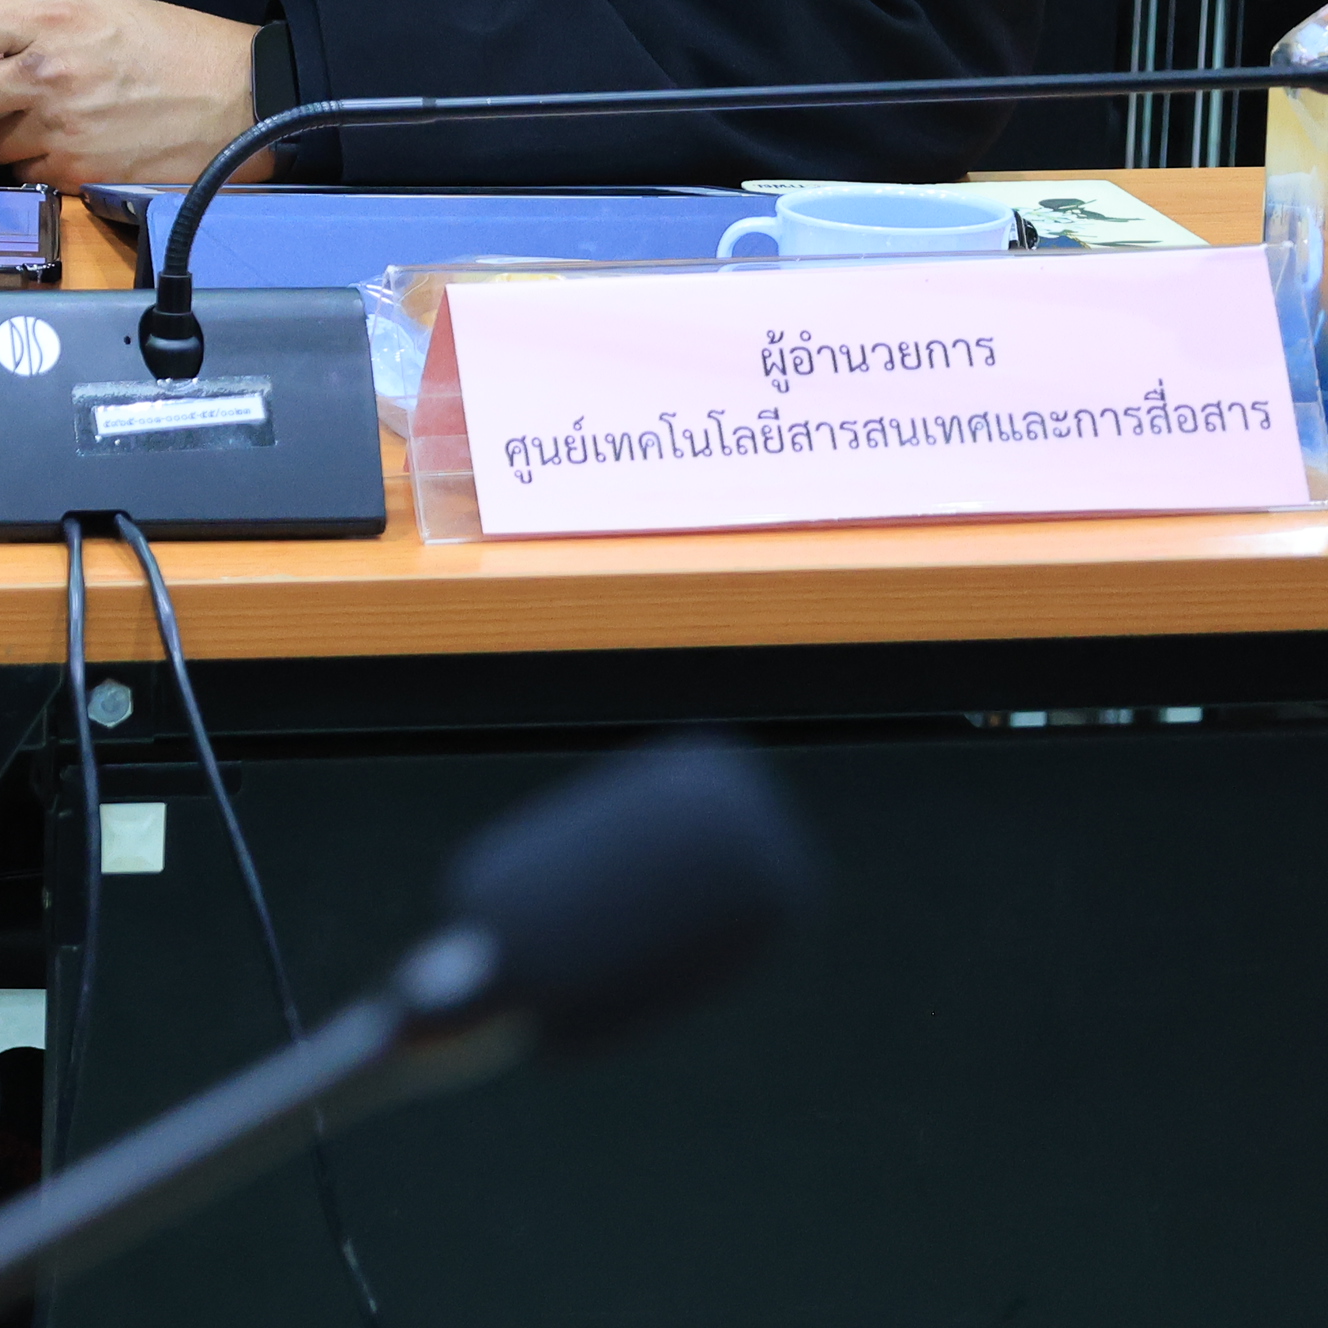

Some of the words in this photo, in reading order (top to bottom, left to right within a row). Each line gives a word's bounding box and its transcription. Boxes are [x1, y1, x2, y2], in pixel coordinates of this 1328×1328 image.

[761, 329, 996, 393] ผู้อำนวยการ
[504, 378, 1272, 485] ศูนย์เทคโนโลยีสารสนเทศและการสื่อสาร
